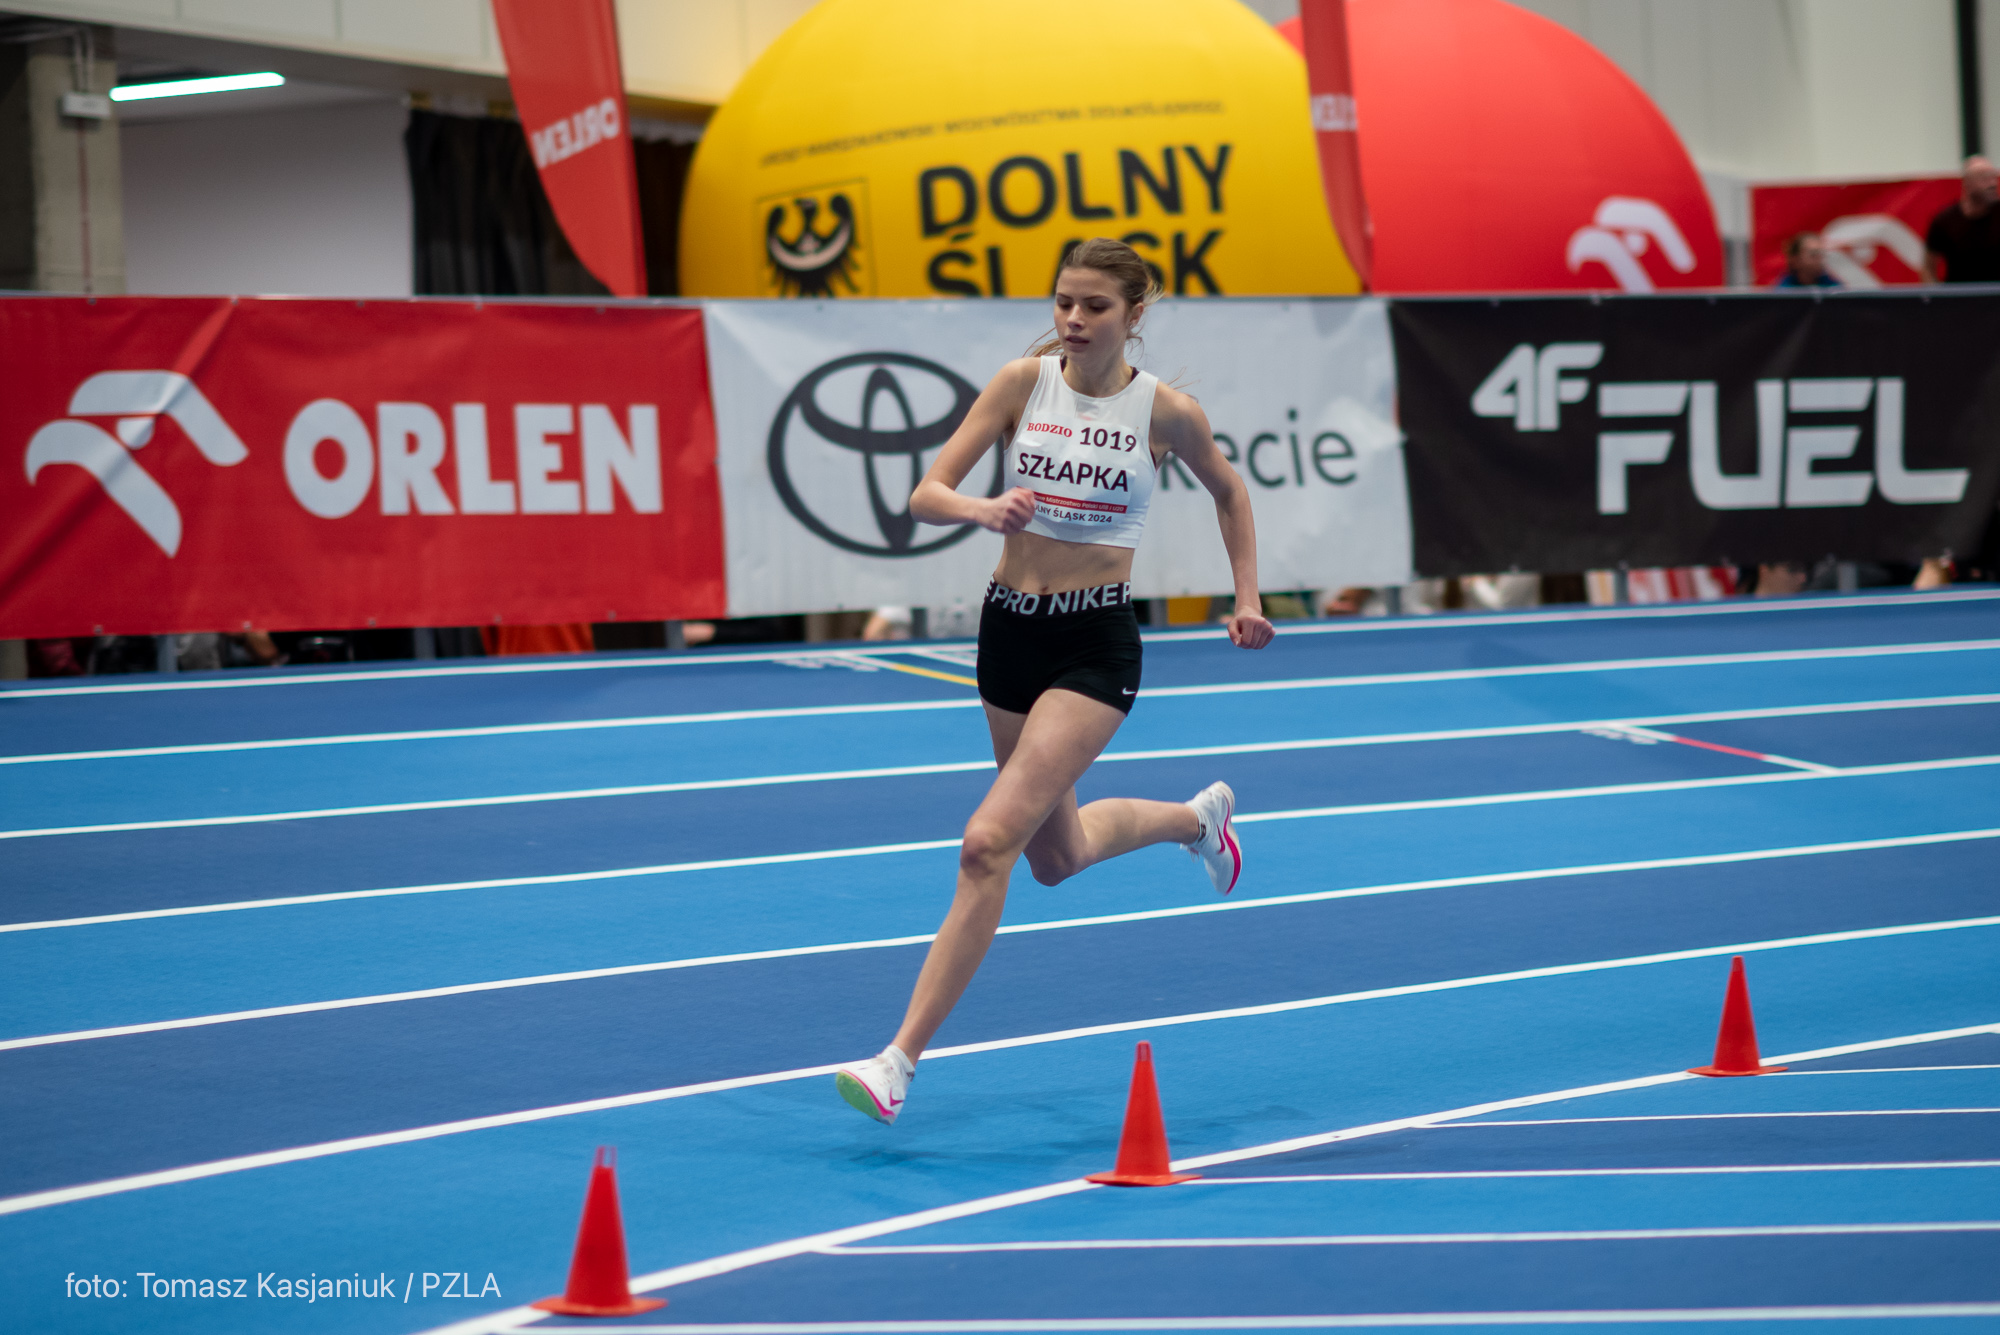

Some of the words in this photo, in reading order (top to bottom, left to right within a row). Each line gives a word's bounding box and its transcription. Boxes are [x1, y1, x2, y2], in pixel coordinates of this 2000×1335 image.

[919, 144, 1232, 239] DOLNY
[926, 228, 1223, 298] ŚLSK
[1027, 422, 1073, 438] BODZIO
[1080, 426, 1137, 453] 1019
[1471, 343, 1604, 431] 4F
[1598, 377, 1970, 514] FUEL
[283, 398, 663, 519] ORLEN
[1017, 452, 1129, 493] SZŁAPKA
[1053, 507, 1086, 522] ŚLĄSK
[1087, 513, 1112, 523] 2024
[990, 584, 1040, 615] PRO
[1047, 583, 1119, 616] NIKE
